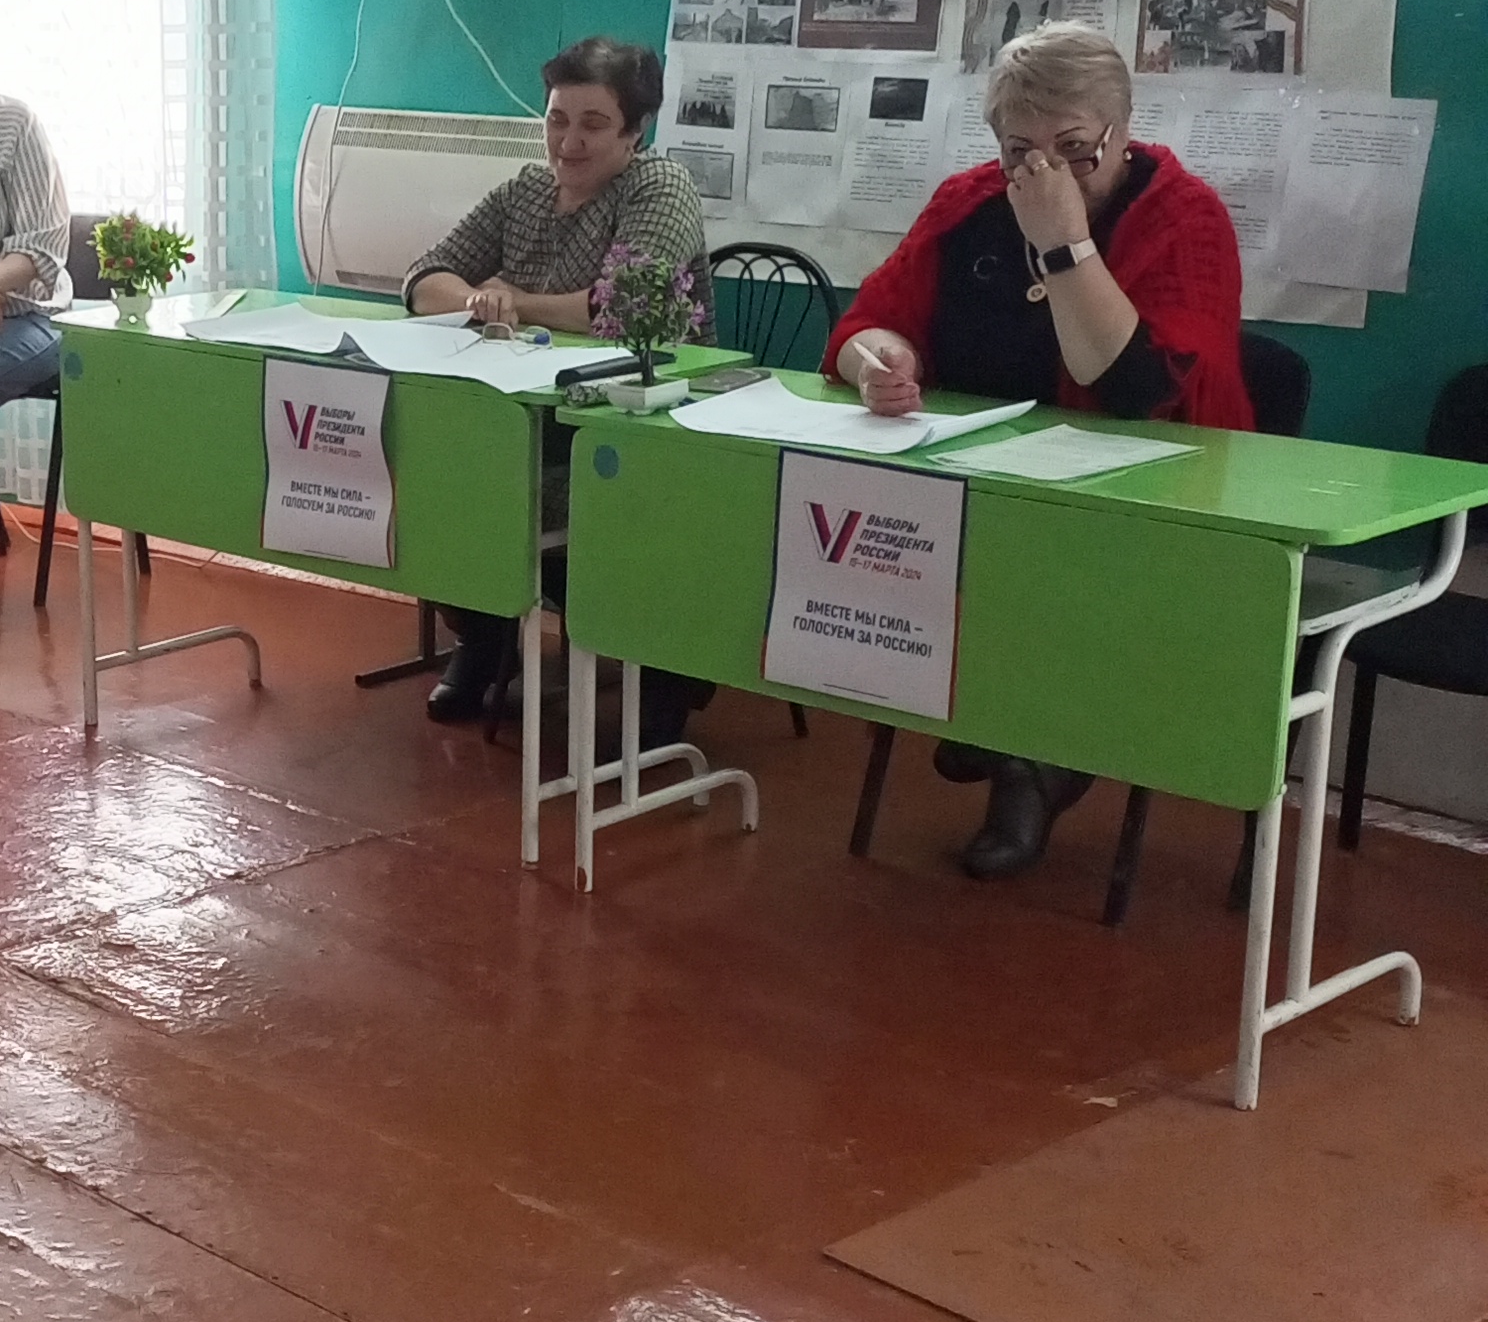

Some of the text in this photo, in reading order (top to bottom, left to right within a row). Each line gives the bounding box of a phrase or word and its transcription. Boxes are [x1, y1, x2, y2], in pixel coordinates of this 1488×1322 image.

[320, 406, 356, 421] ВЫБОРЫ
[317, 419, 365, 436] ПРЕЗИДЕНТА
[314, 432, 345, 445] РОССИИ
[290, 480, 322, 496] ВМЕСТЕ
[324, 486, 339, 499] МЫ
[340, 488, 363, 502] СИЛА
[281, 494, 376, 521] ГОЛОСУЕМ ЗА РОССИЮ!
[866, 513, 920, 534] ВЫБОРЫ
[860, 529, 935, 554] ПРЕЗИДЕНТА
[853, 543, 902, 563] РОССИИ
[872, 561, 900, 578] МАРТА
[806, 599, 852, 622] ВМЕСТЕ
[854, 610, 876, 626] МЫ
[878, 614, 912, 635] СИЛА
[793, 615, 933, 659] ГОЛОСУЕМ ЗА РОССИЮ!
